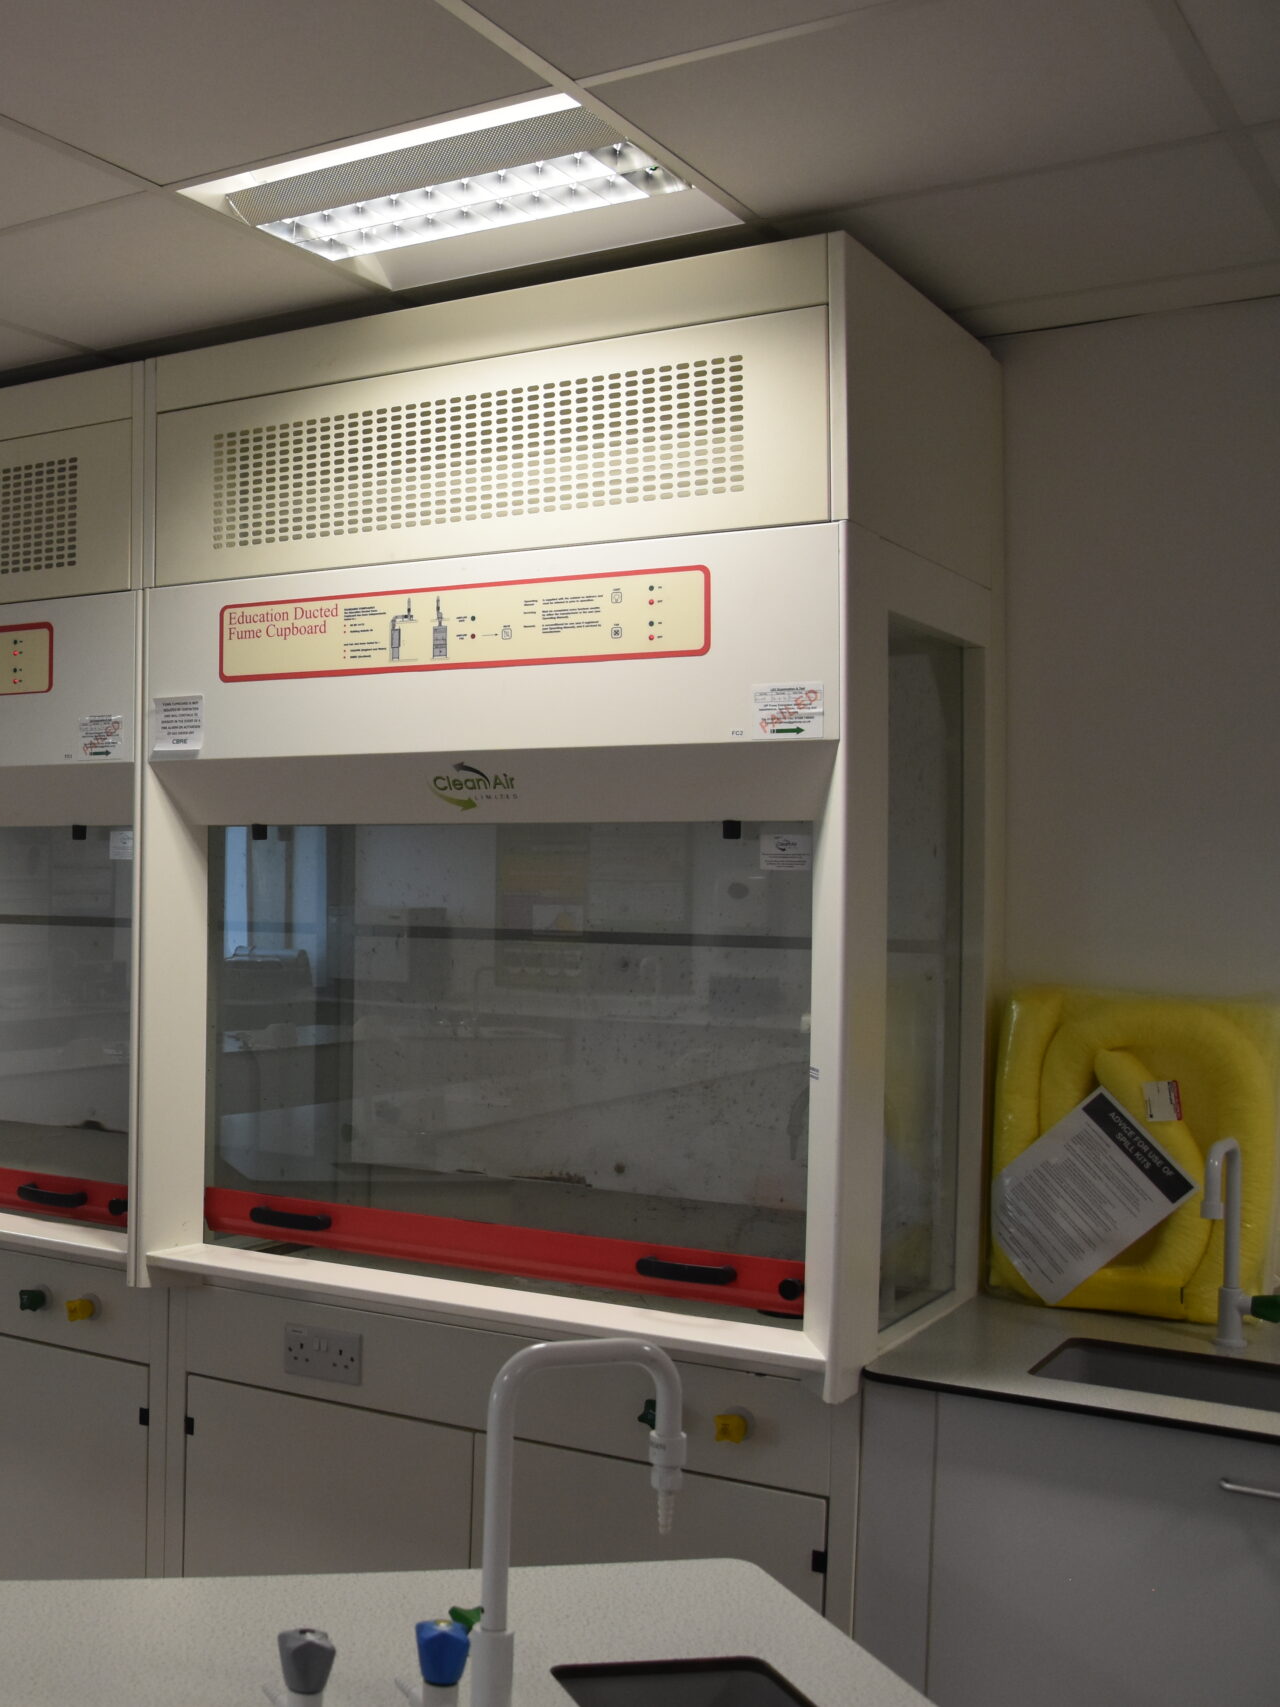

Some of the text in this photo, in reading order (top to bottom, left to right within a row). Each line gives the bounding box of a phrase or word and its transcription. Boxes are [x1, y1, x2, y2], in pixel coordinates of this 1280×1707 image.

[228, 608, 289, 625] Education
[294, 603, 338, 620] Ducted
[228, 620, 327, 641] Fume Cupboard
[1108, 1111, 1175, 1177] ADVICE FOR USE OF
[1115, 1132, 1152, 1169] SPILL KITS
